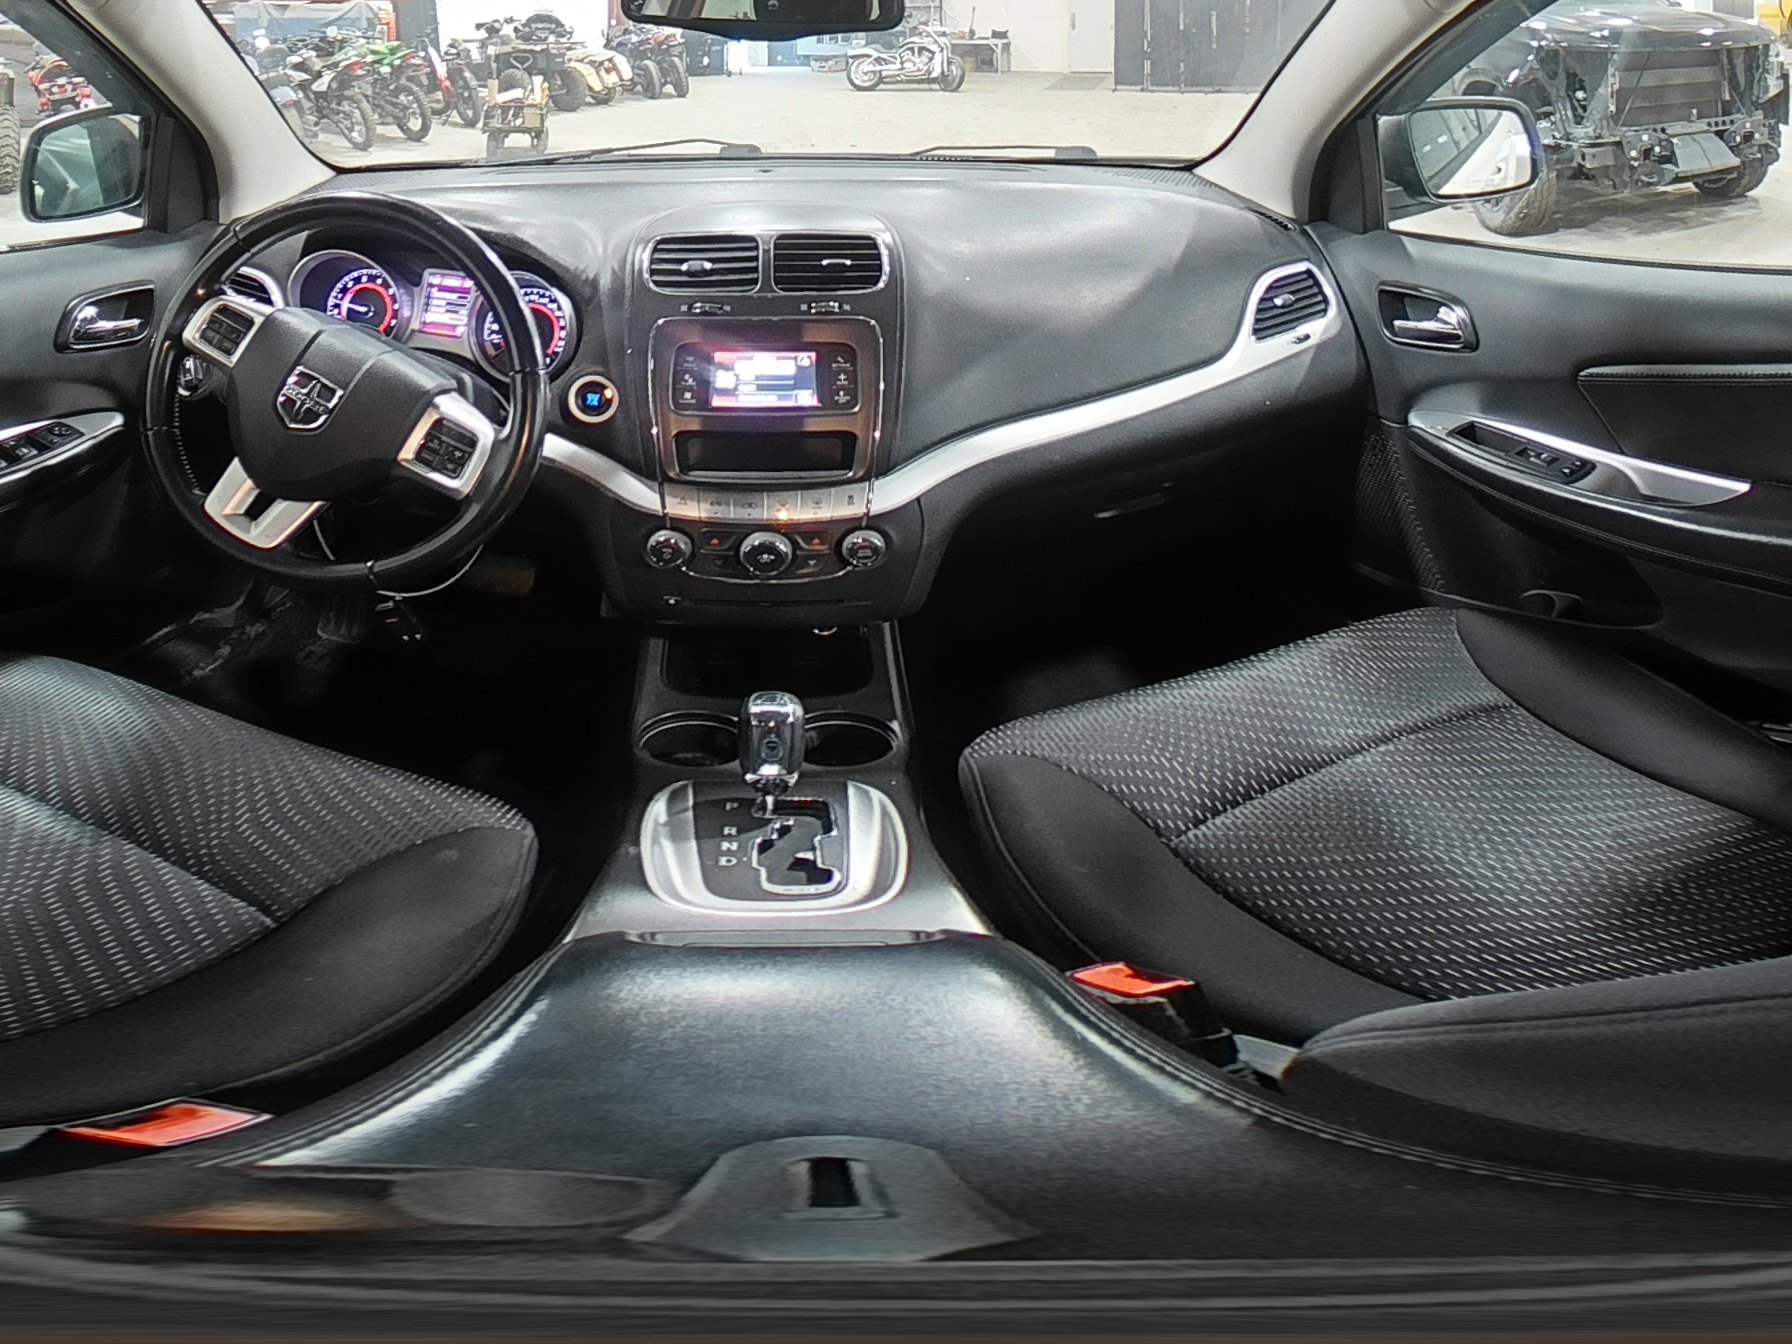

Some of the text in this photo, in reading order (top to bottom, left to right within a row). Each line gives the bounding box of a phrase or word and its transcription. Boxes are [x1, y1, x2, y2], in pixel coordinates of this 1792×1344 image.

[725, 802, 739, 811] P
[724, 826, 737, 836] R
[721, 841, 738, 850] N
[718, 856, 737, 866] D
